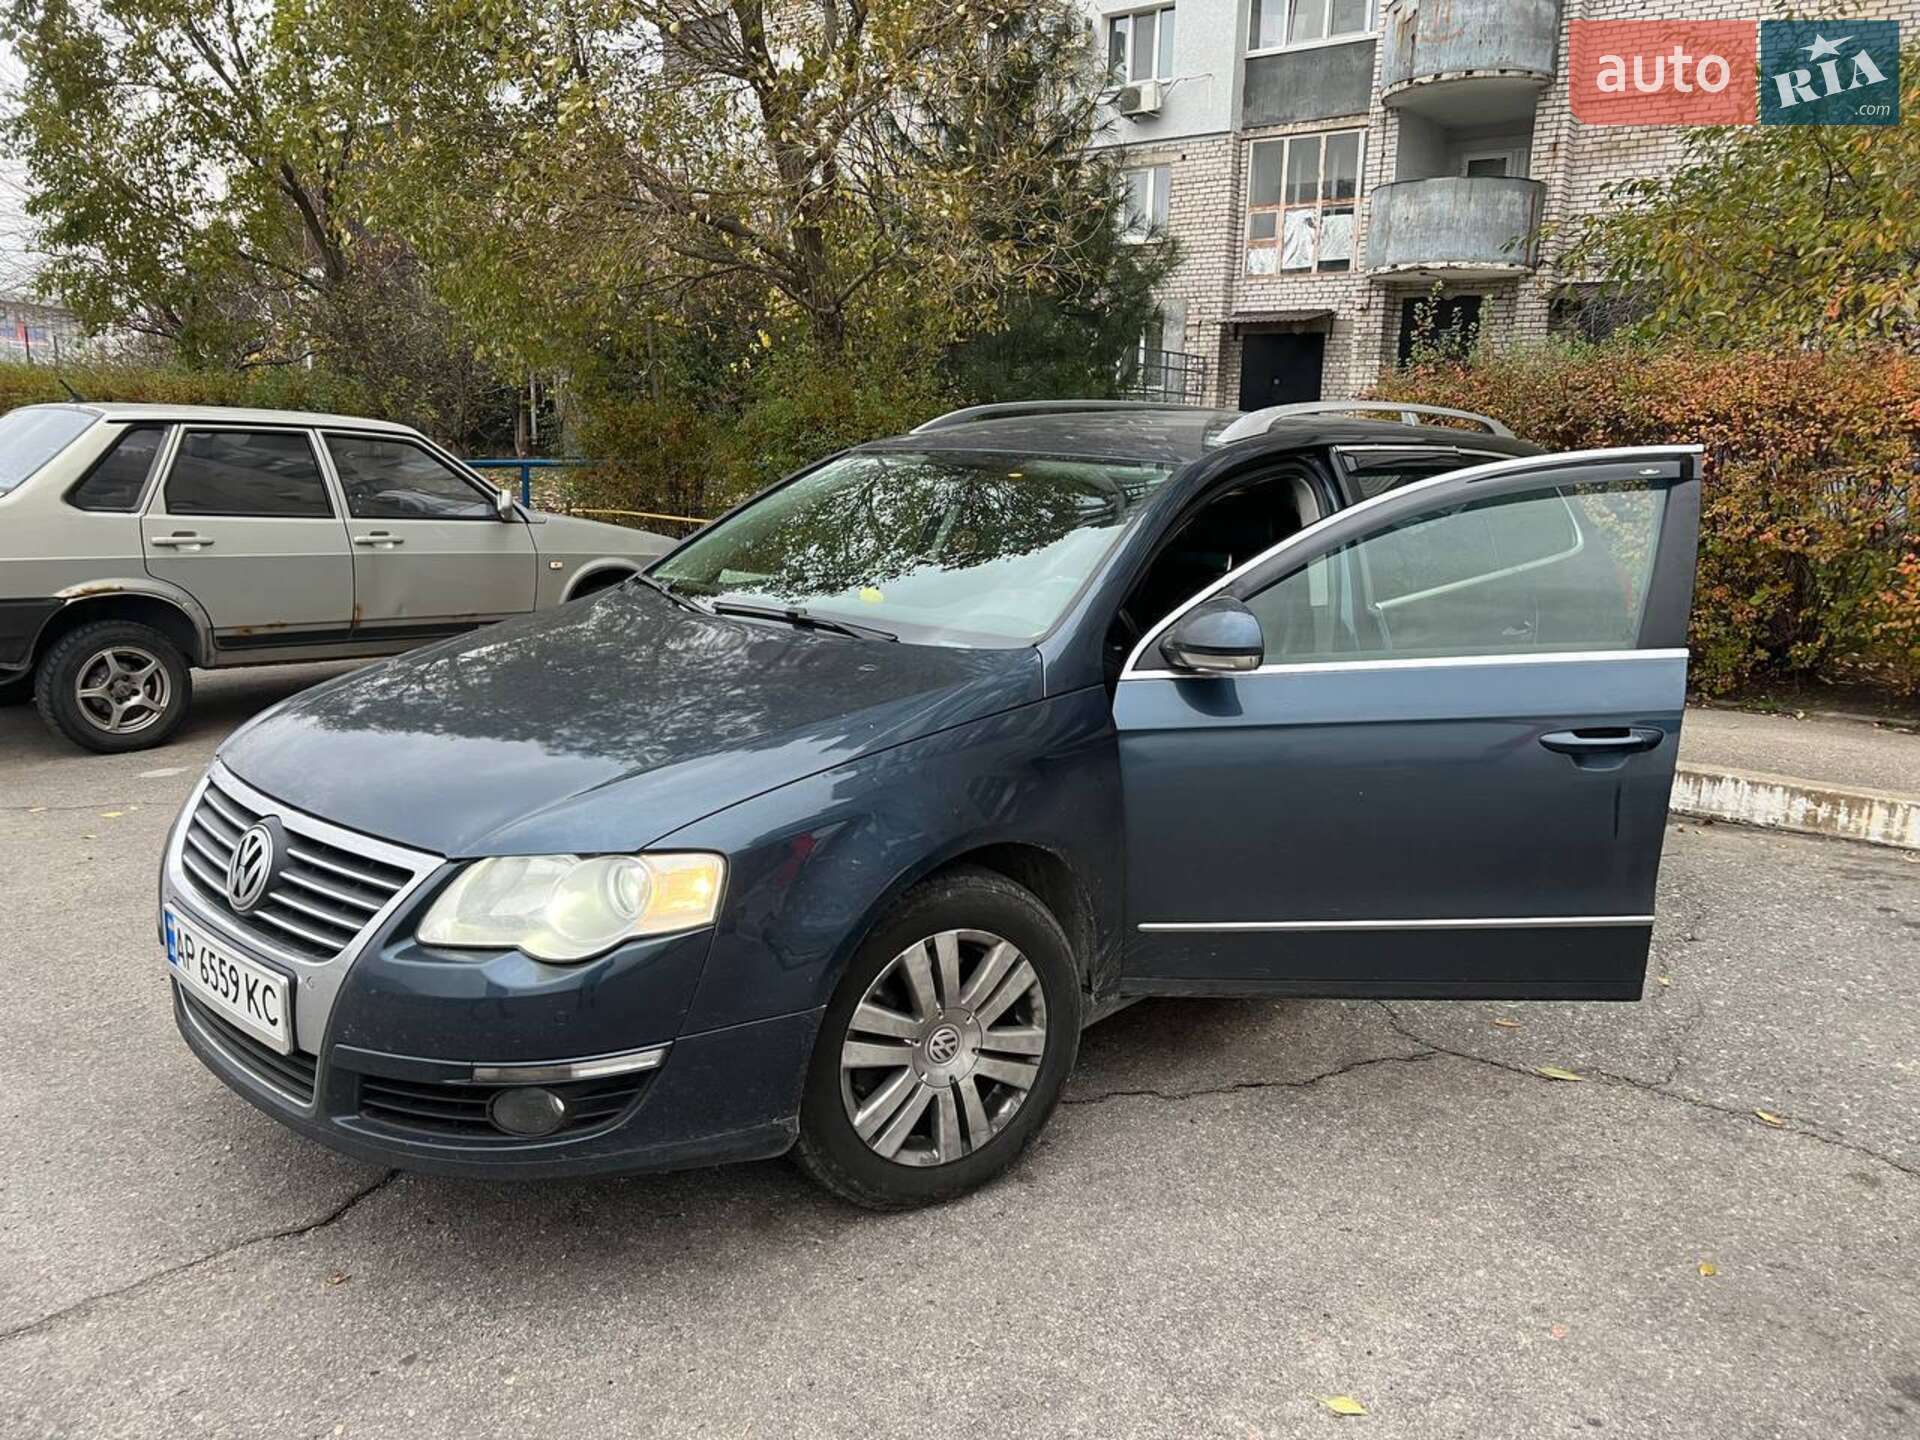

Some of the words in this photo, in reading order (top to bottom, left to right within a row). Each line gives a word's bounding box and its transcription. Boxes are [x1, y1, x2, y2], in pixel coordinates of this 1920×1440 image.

[176, 927, 195, 970] AP
[200, 947, 240, 1004] 6559
[245, 973, 278, 1027] KC
